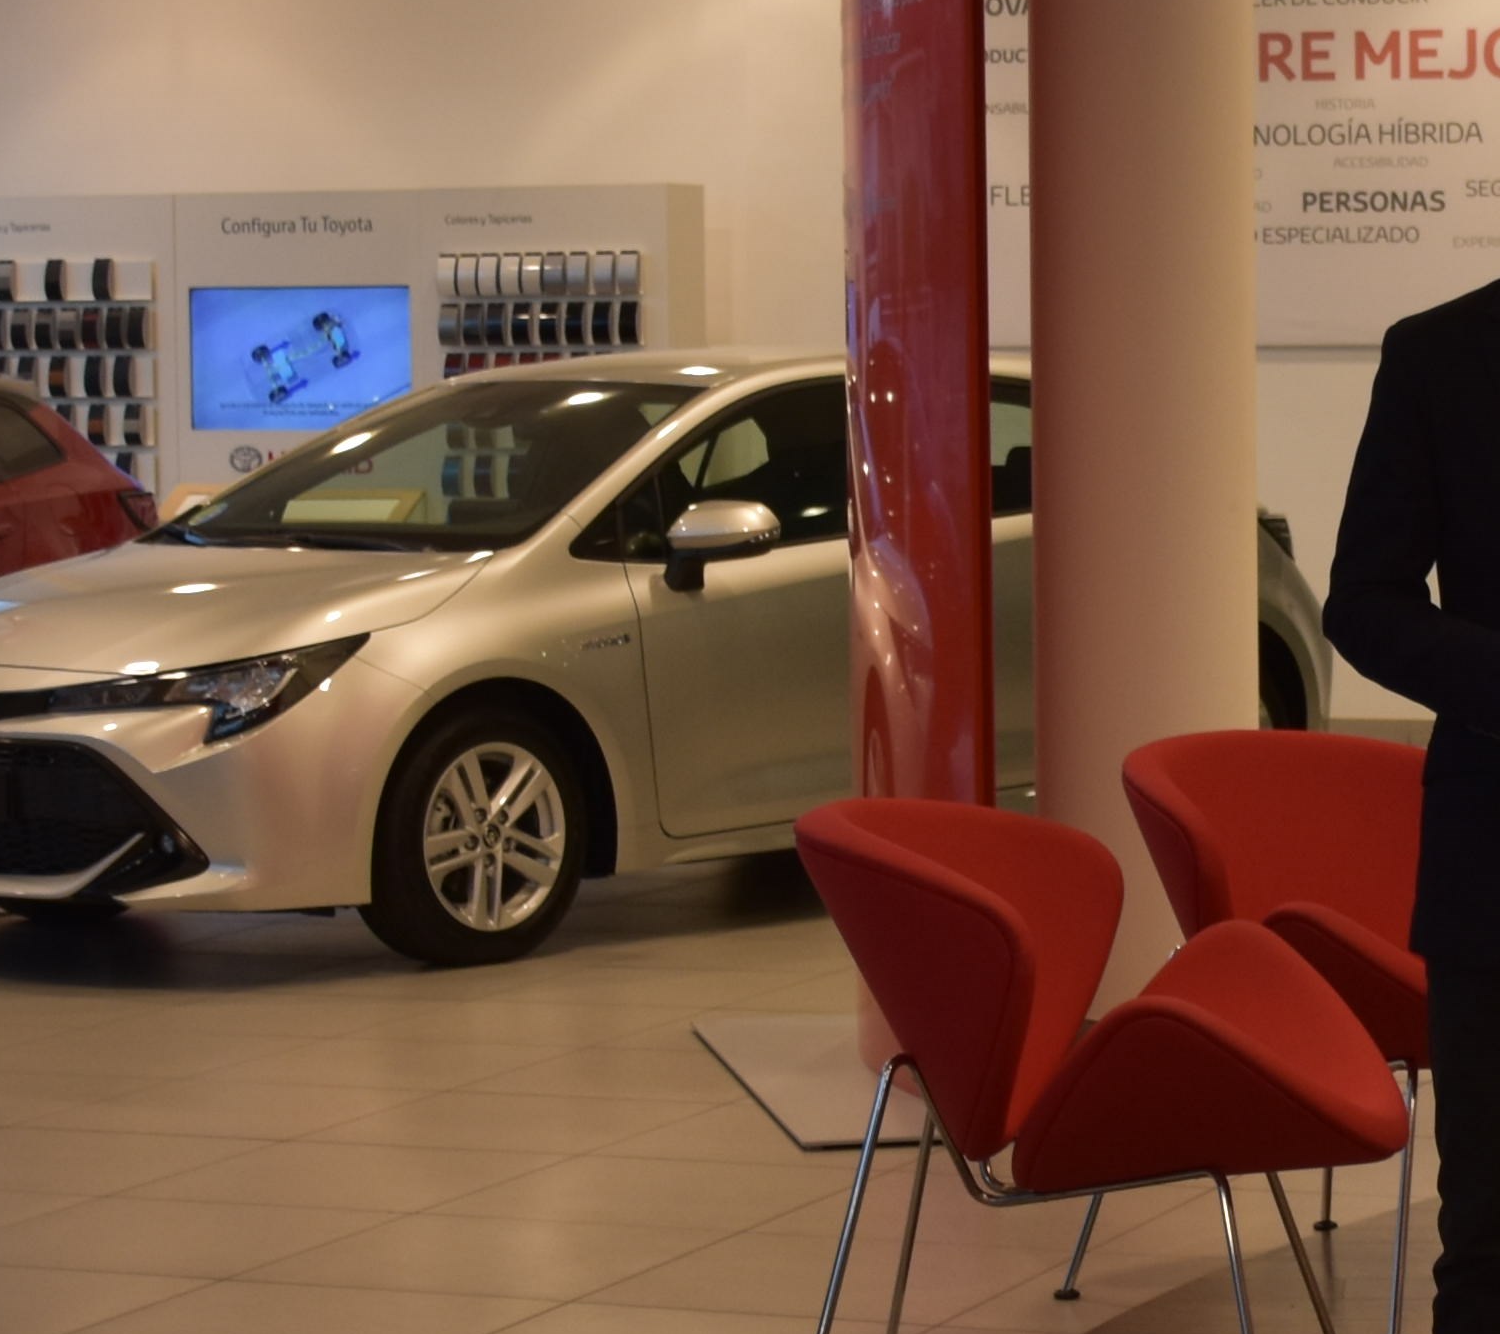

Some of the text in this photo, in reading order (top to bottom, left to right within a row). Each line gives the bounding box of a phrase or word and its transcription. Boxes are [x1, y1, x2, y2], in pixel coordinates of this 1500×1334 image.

[1315, 97, 1376, 111] HISTORIA
[1378, 117, 1484, 145] HÍBRIDA
[1333, 156, 1429, 169] ACCESIBILIDAD
[1302, 190, 1446, 213] PERSONAS
[220, 215, 373, 237] Configura Tu Toyota
[1262, 225, 1421, 245] ESPECIALIZADO
